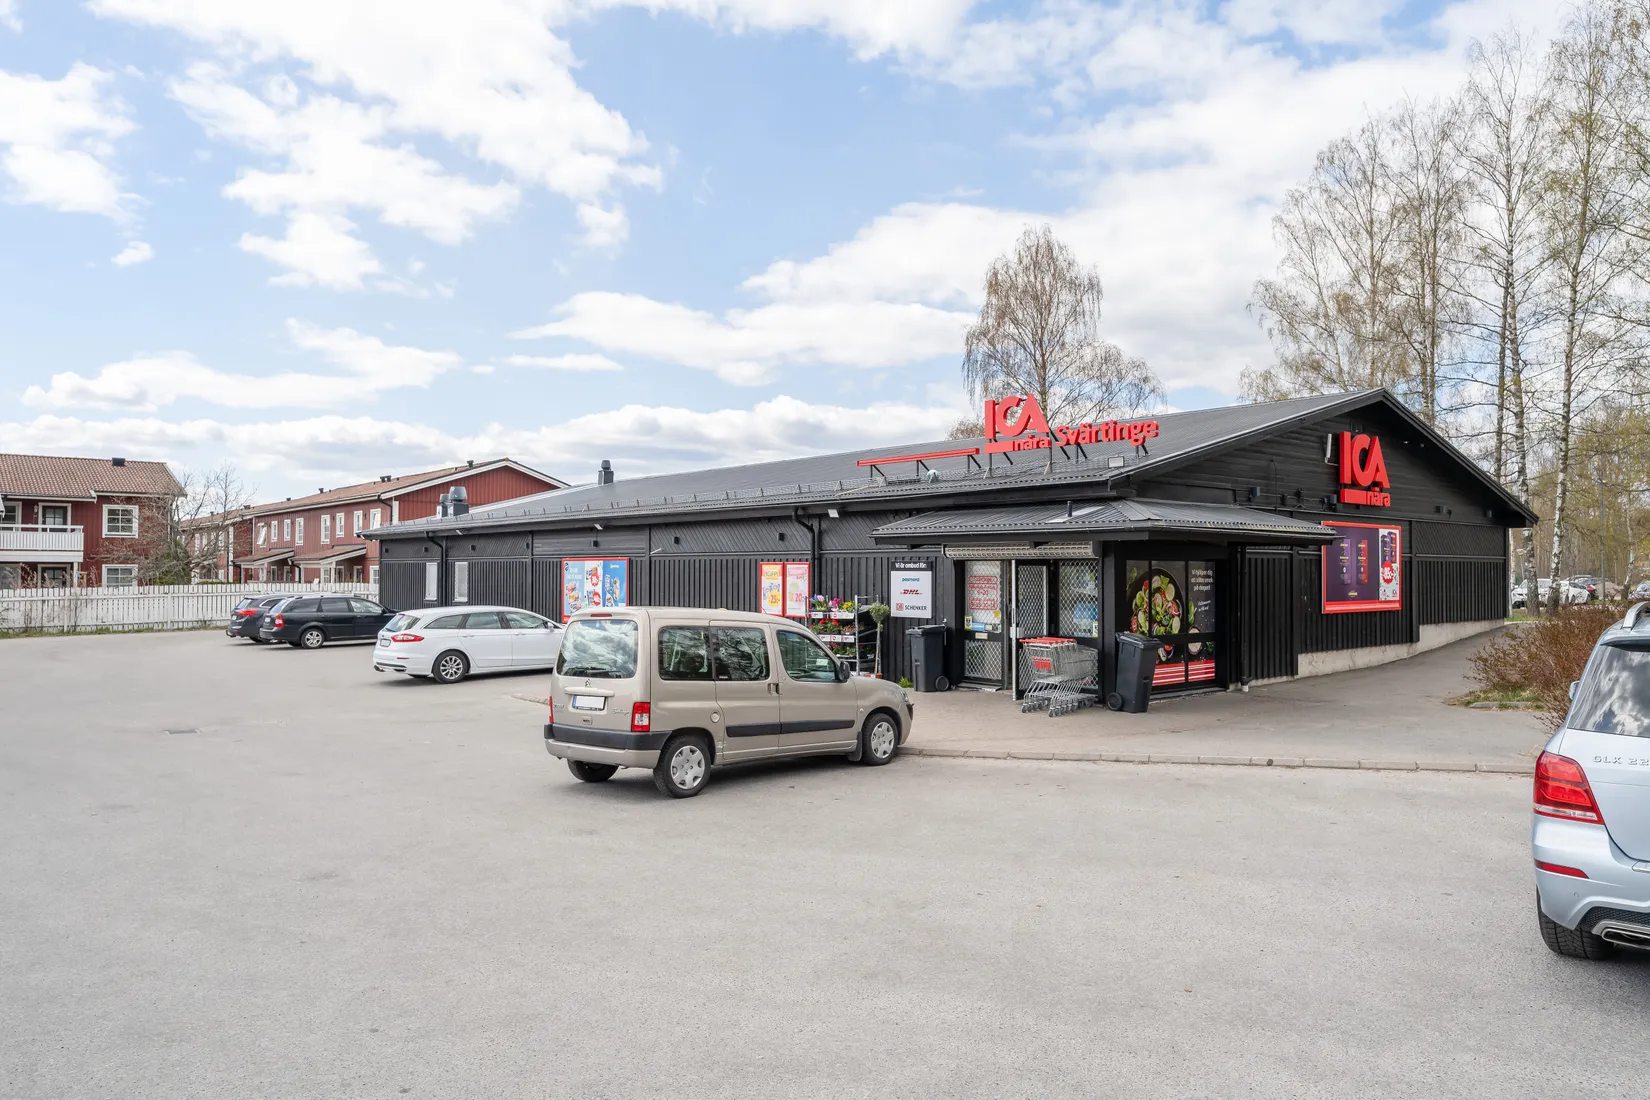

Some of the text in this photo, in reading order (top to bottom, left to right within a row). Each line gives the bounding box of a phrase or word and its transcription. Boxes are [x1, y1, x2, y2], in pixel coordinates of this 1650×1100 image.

[984, 393, 1050, 440] ICA
[1013, 435, 1051, 451] nära
[1055, 420, 1159, 447] Svärtinge
[1339, 431, 1391, 489] ICA
[1365, 486, 1391, 508] nära
[1593, 756, 1622, 765] GLK
